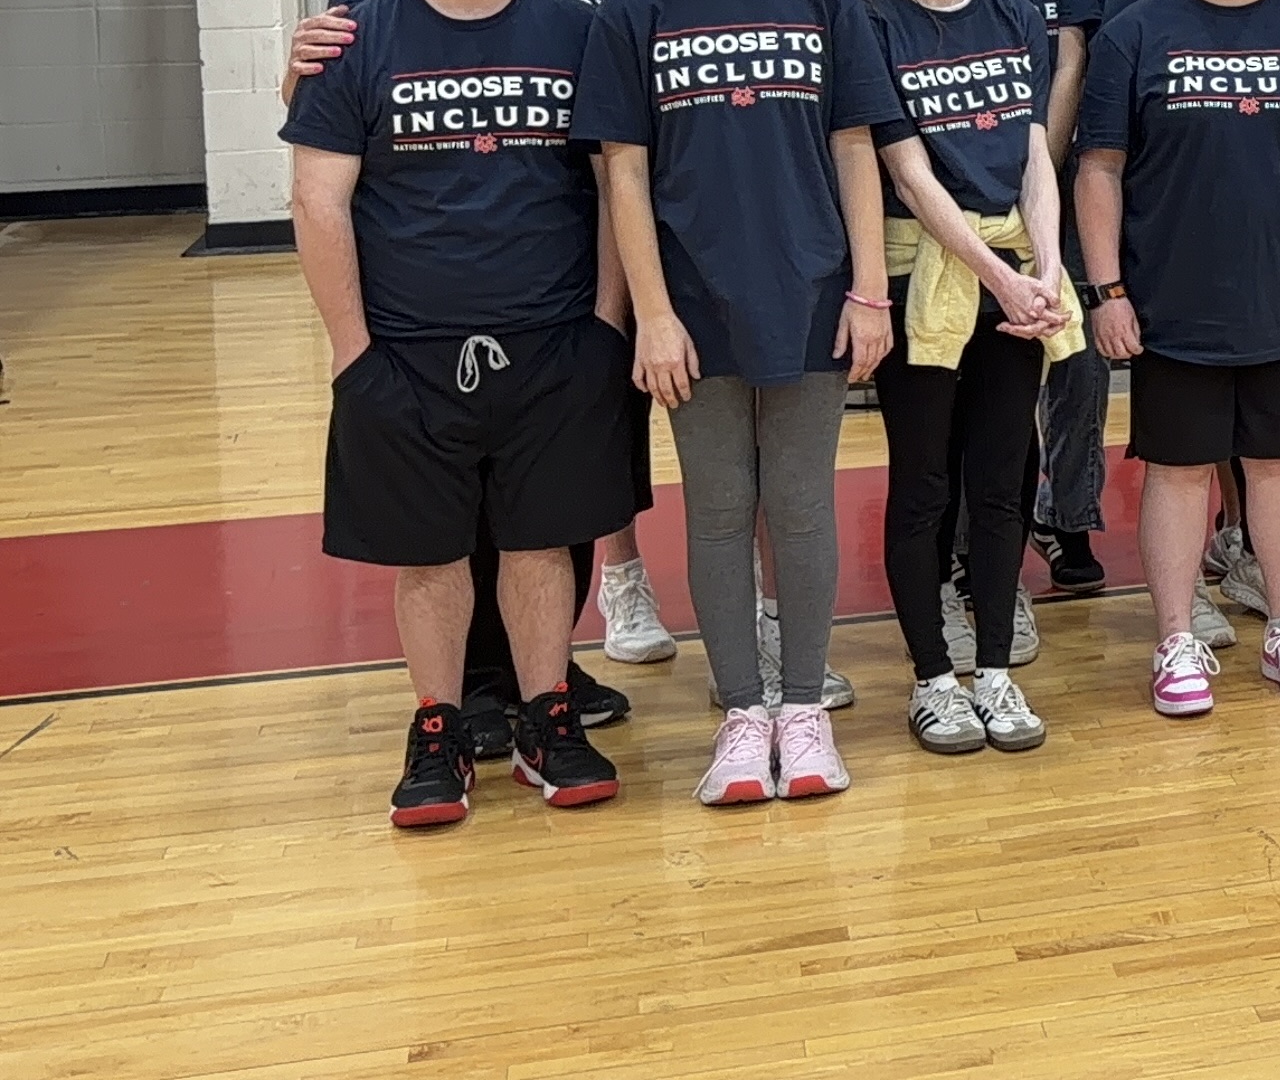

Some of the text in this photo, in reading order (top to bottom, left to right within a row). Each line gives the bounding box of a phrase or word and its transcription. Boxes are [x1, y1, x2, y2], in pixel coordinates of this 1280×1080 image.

[654, 32, 822, 62] CHOOSE TO
[655, 59, 821, 92] INCLUDE
[902, 58, 1005, 90] CHOOSE
[1168, 56, 1280, 73] CHOOSE
[392, 76, 572, 104] CHOOSE TO
[393, 106, 570, 133] INCLUDE
